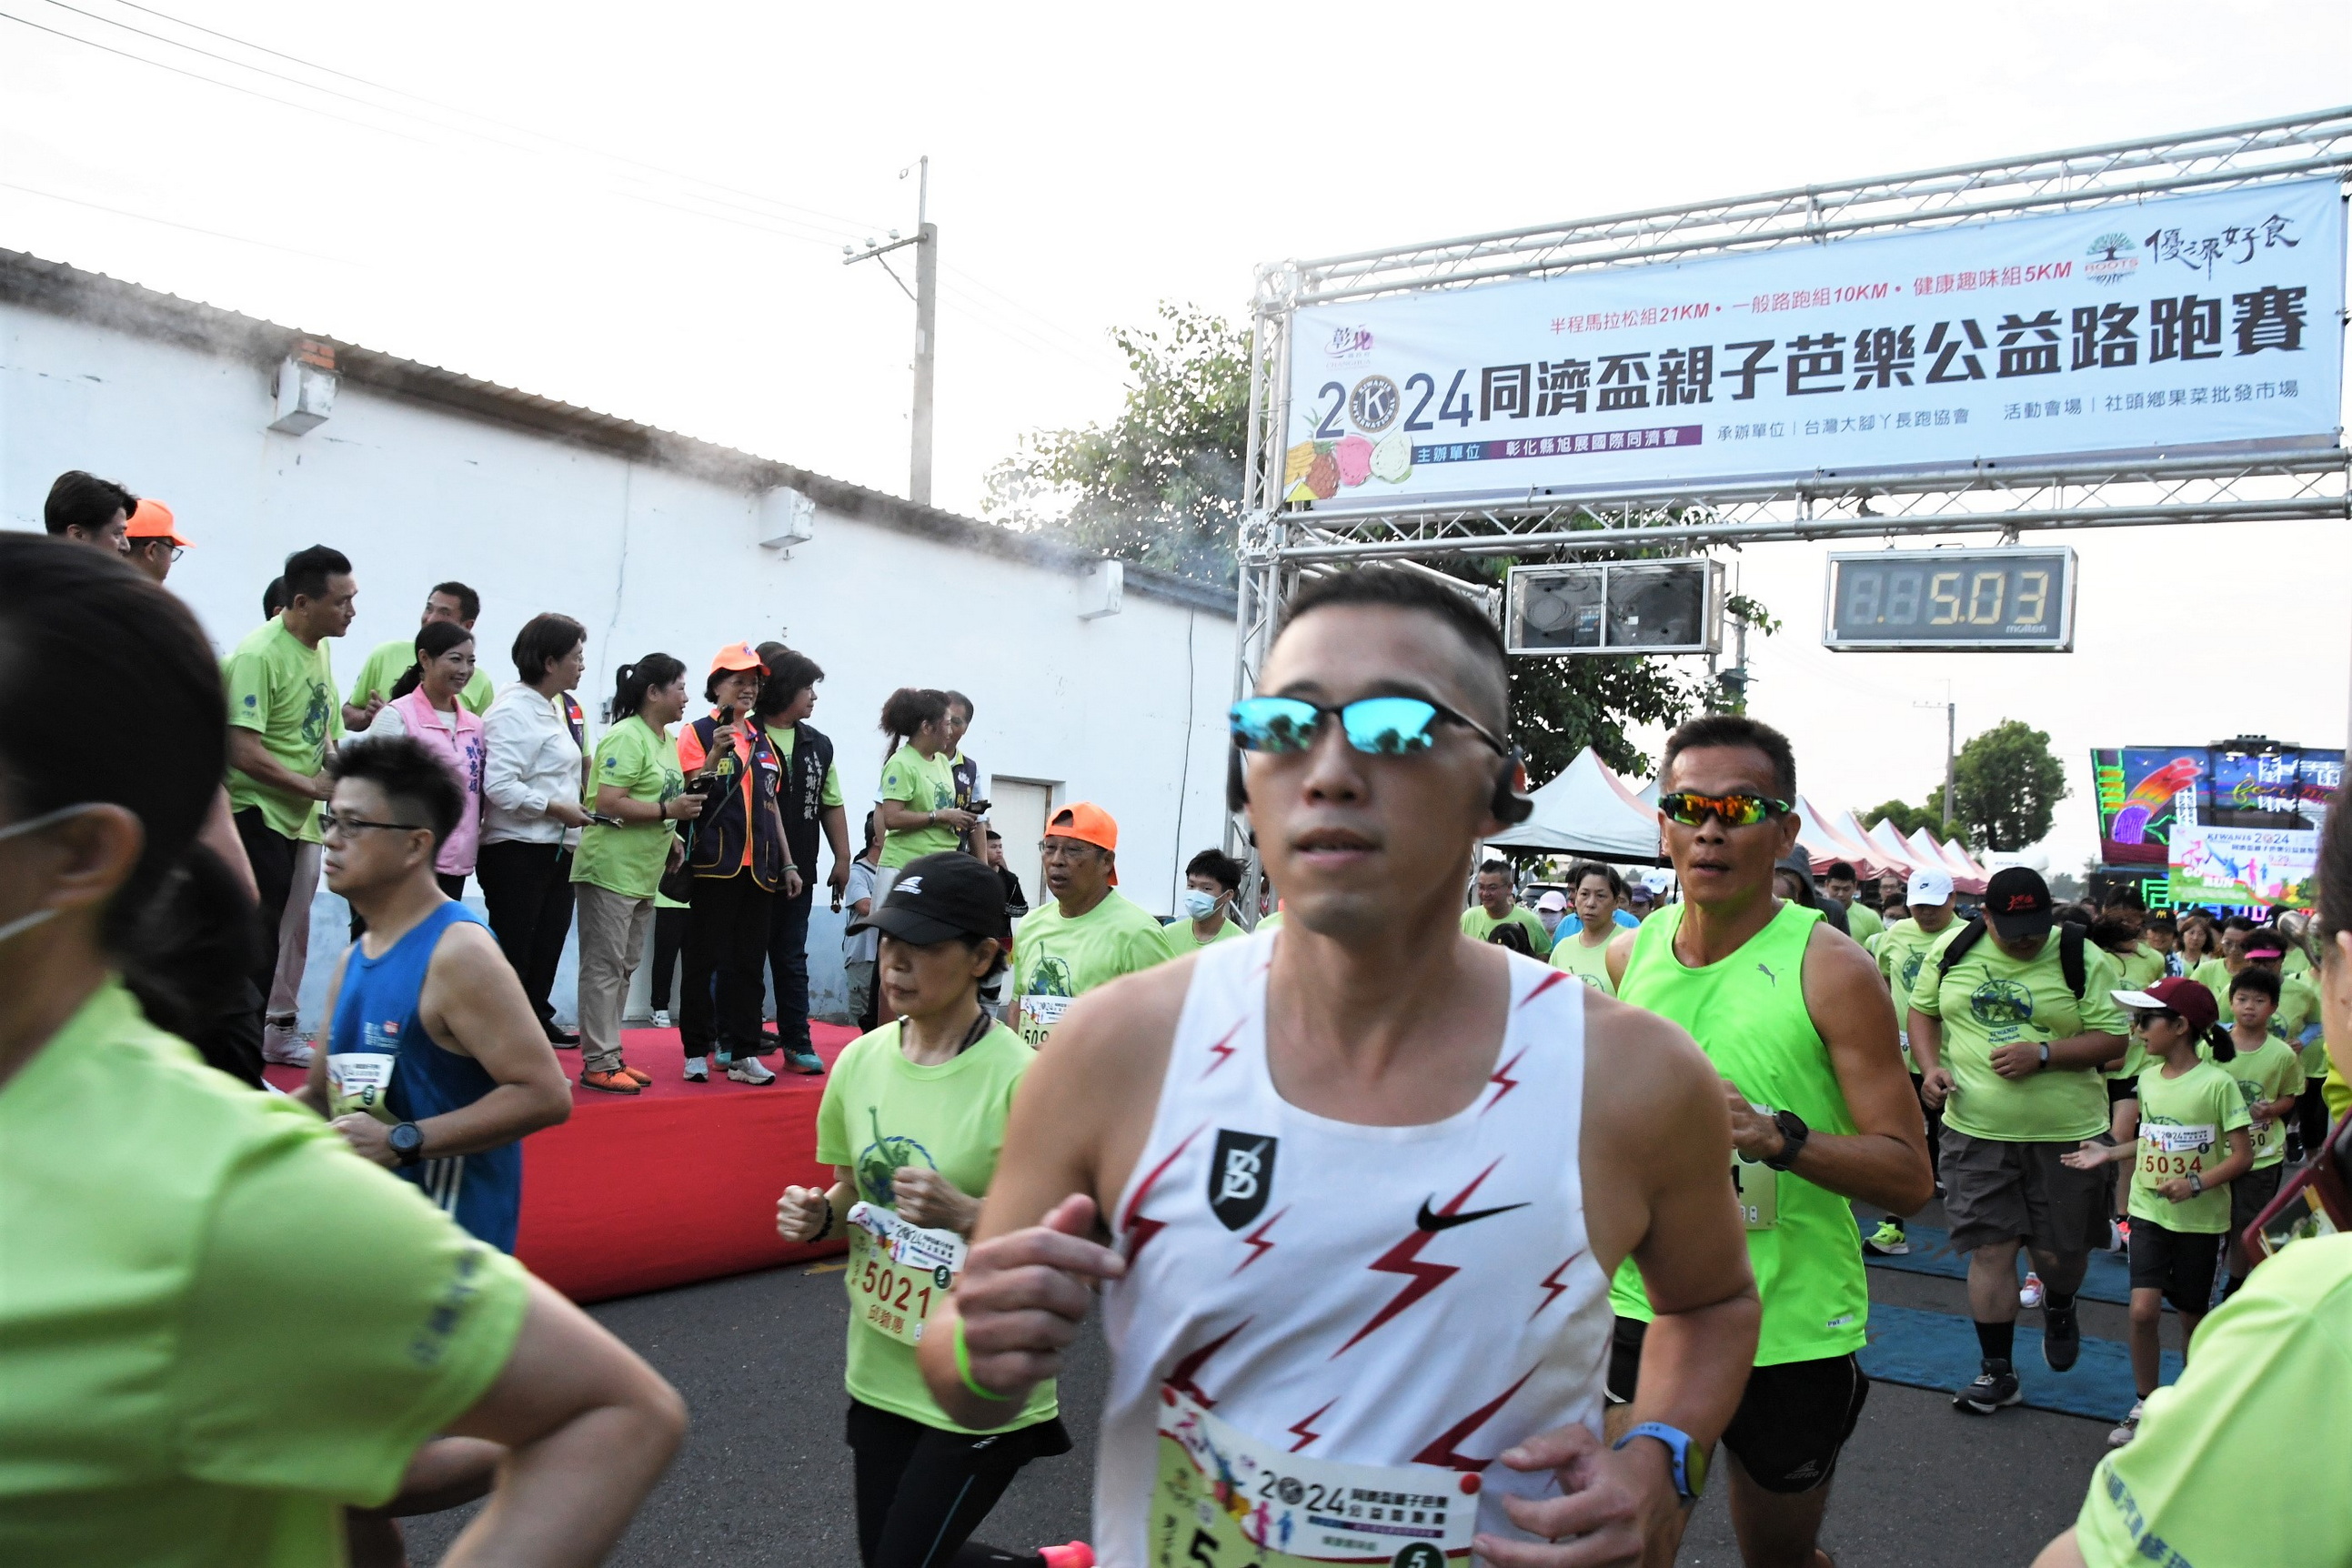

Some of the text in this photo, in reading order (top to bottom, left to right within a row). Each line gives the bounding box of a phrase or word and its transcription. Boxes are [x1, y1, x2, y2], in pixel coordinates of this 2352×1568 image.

[1550, 260, 2073, 336] 半程馬拉松組21KM 一般路跑組10KM 健康趣味組5KM
[2004, 379, 2299, 421] 活動會場 社頭鄉果菜批發市場
[1417, 428, 1680, 464] 主辦單位 彰化縣旭展國際同濟會
[1717, 421, 1785, 441] 承辦單位
[2005, 623, 2047, 635] molten
[2146, 1155, 2203, 1174] 5034
[862, 1260, 931, 1320] 5021
